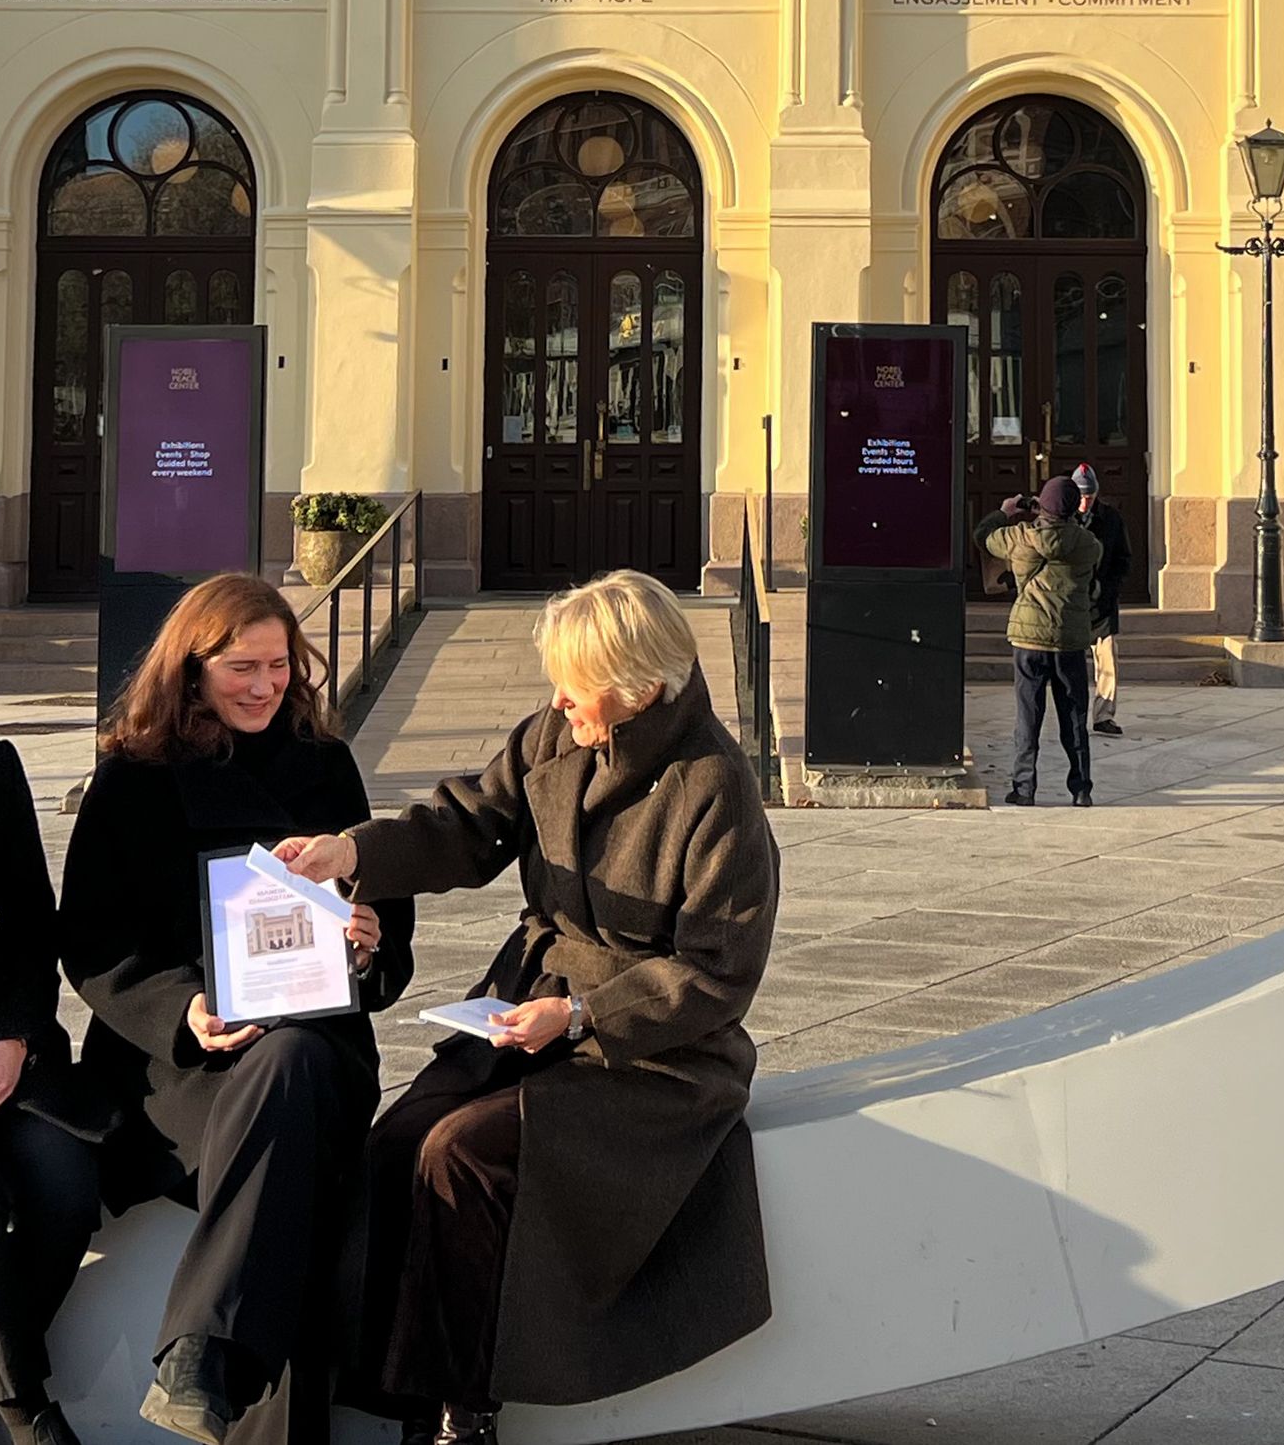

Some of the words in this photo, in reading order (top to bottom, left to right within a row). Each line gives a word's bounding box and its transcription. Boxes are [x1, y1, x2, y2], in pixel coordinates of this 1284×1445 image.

[161, 441, 205, 450] Exhibitions
[867, 439, 911, 448] Exhibitions
[155, 450, 182, 459] Events
[190, 450, 210, 460] Shop
[861, 448, 888, 456] Events
[895, 448, 916, 458] Shop
[157, 459, 185, 468] Guided
[187, 459, 208, 468] tours
[863, 457, 892, 465] Guided
[893, 457, 914, 466] tours
[152, 470, 176, 478] every
[177, 468, 213, 476] weekend
[883, 466, 918, 474] weekend
